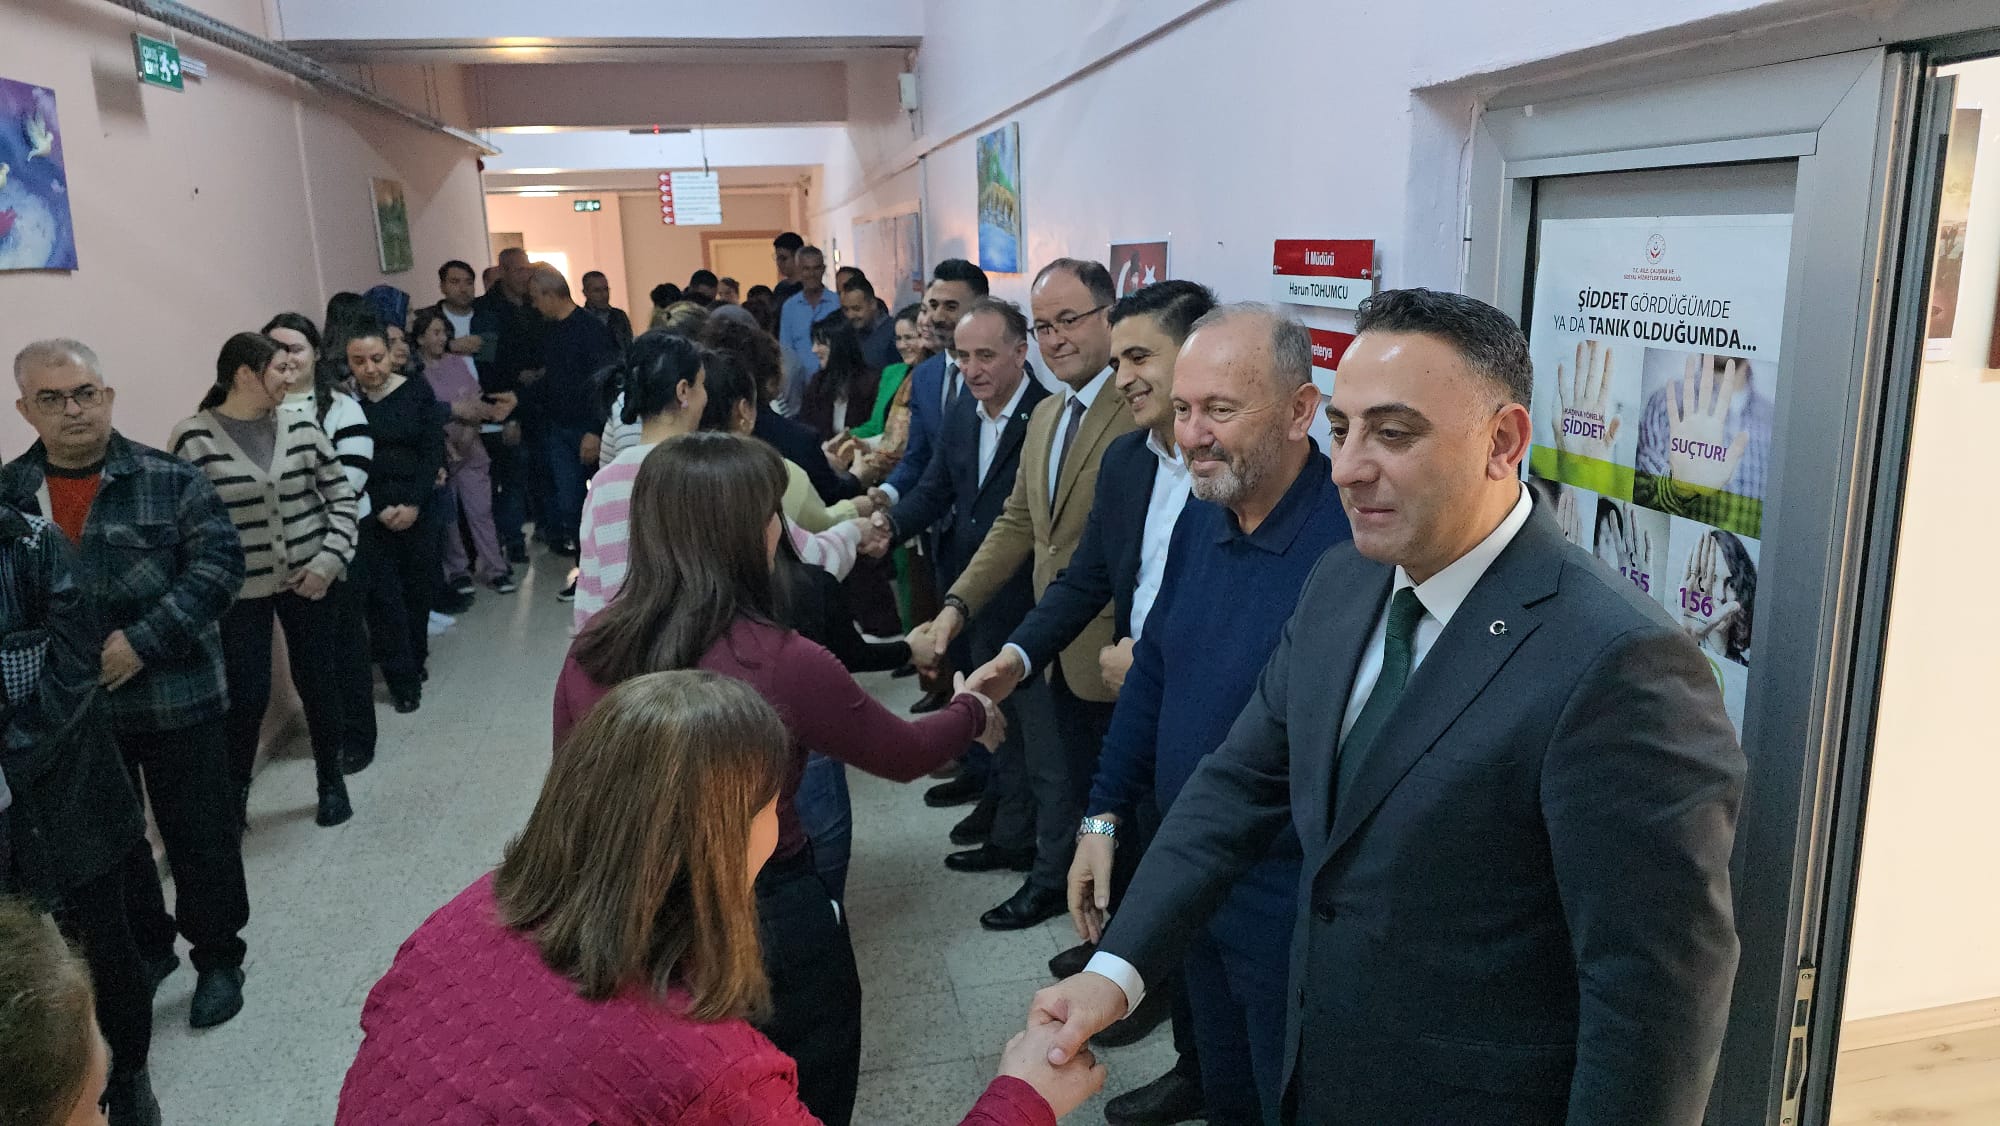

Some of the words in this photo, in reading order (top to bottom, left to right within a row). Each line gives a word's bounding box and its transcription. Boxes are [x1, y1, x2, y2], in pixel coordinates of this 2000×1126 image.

[1305, 248, 1310, 265] İl
[1310, 250, 1335, 266] Müdürü
[1289, 281, 1309, 296] Harun
[1310, 283, 1349, 300] TOHUMCU
[1578, 286, 1629, 312] ŞİDDET
[1630, 292, 1731, 319] GÖRDÜĞÜMDE
[1553, 314, 1566, 332] YA
[1569, 316, 1586, 333] DA
[1589, 316, 1631, 338] TANIK
[1633, 320, 1757, 352] OLDUĞUMDA...
[1311, 343, 1333, 361] reterya
[1563, 416, 1605, 440] ŞİDDET
[1671, 437, 1727, 462] SUÇTUR!
[1680, 587, 1713, 617] 156
